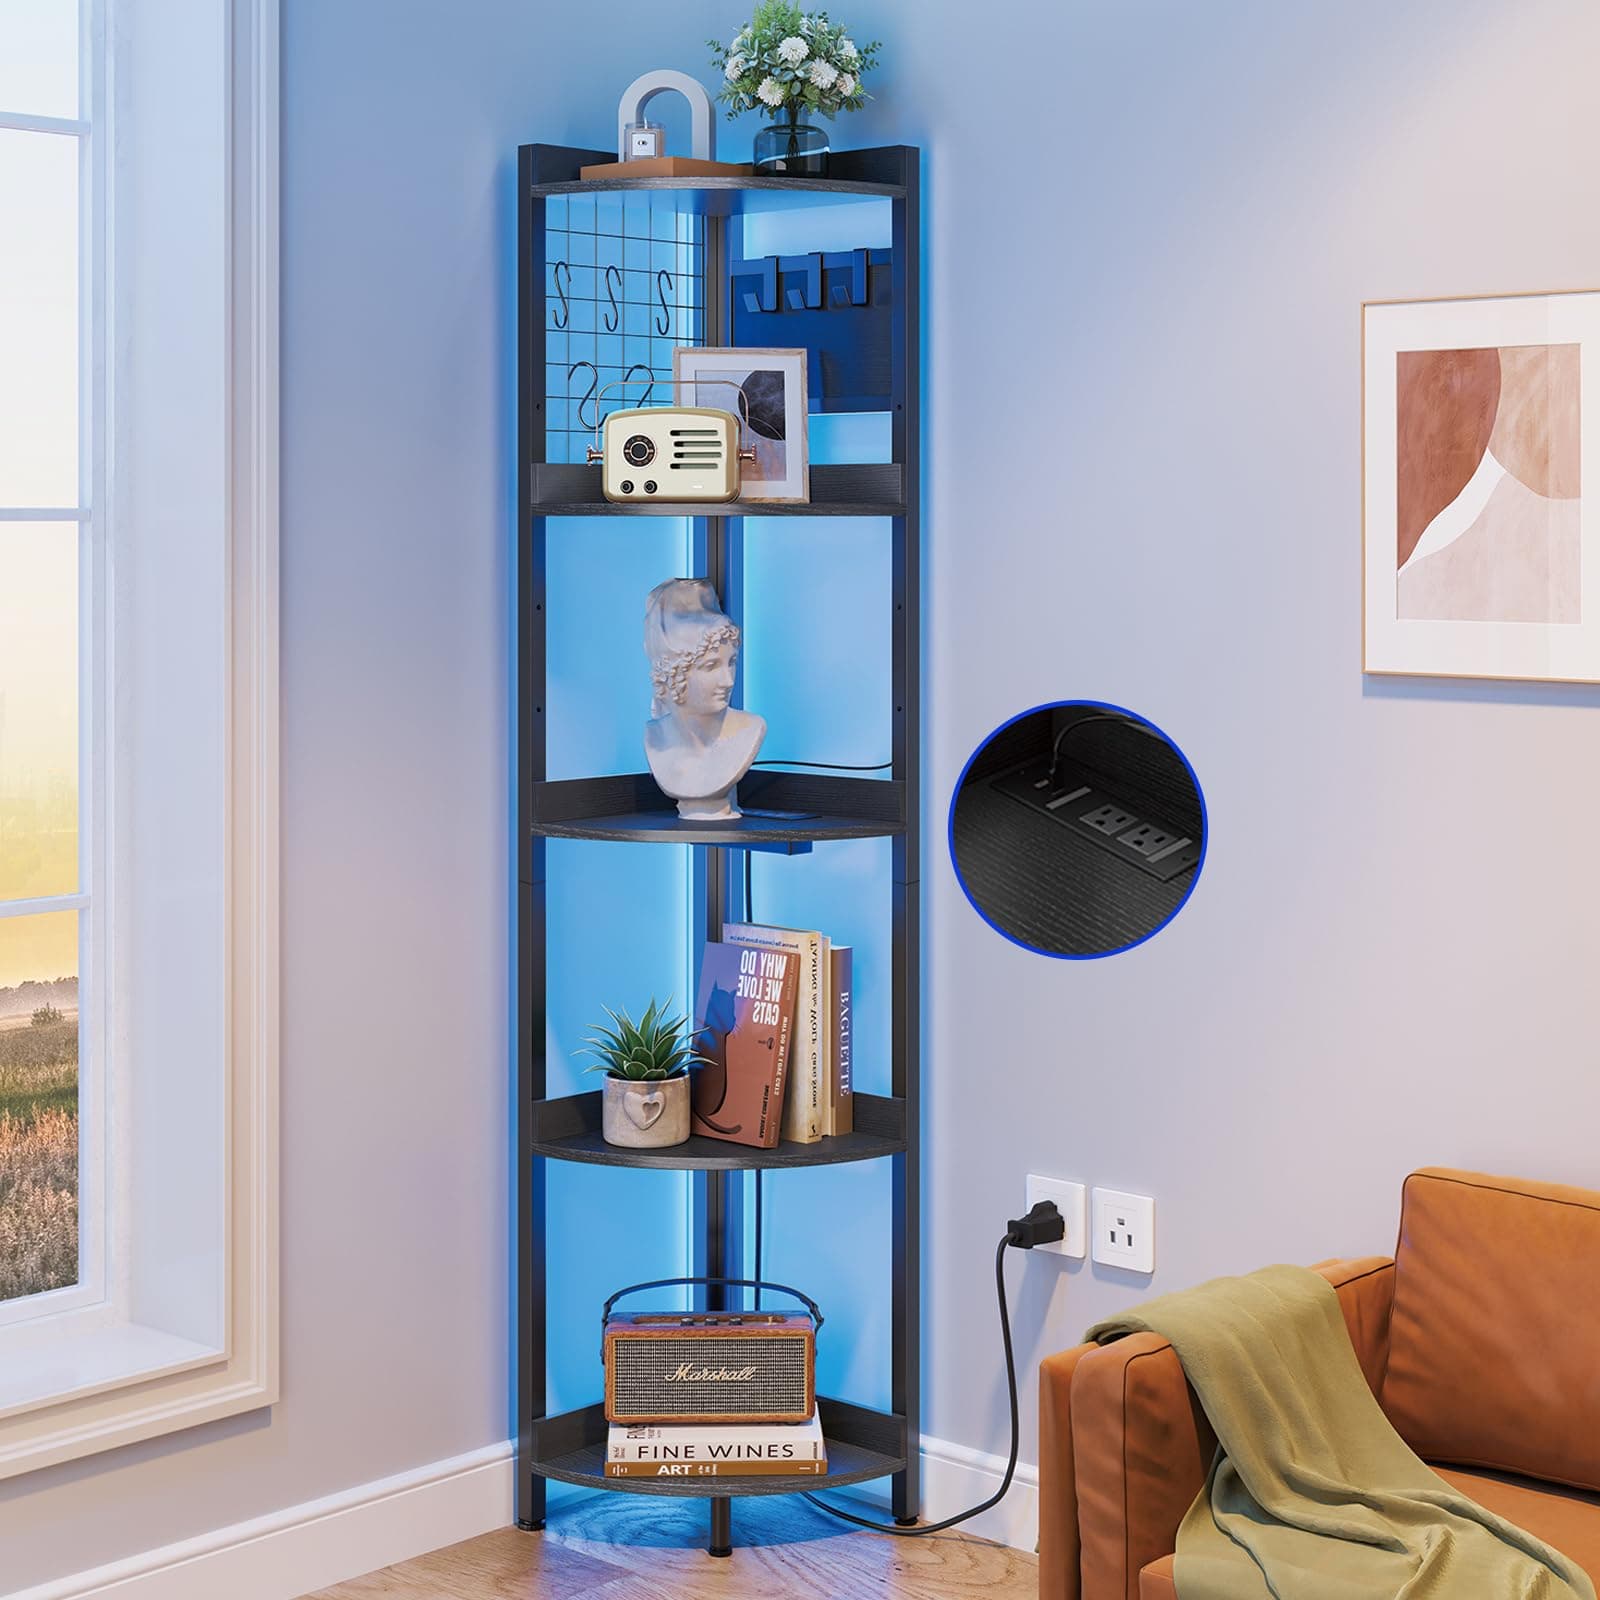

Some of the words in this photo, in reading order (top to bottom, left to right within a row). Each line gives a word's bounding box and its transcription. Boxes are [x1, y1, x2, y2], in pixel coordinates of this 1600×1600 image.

[840, 992, 850, 1096] BAGUETTE
[665, 1363, 756, 1382] Marshall
[638, 1445, 695, 1459] FINE
[708, 1444, 794, 1458] WINES
[656, 1464, 692, 1476] ART
